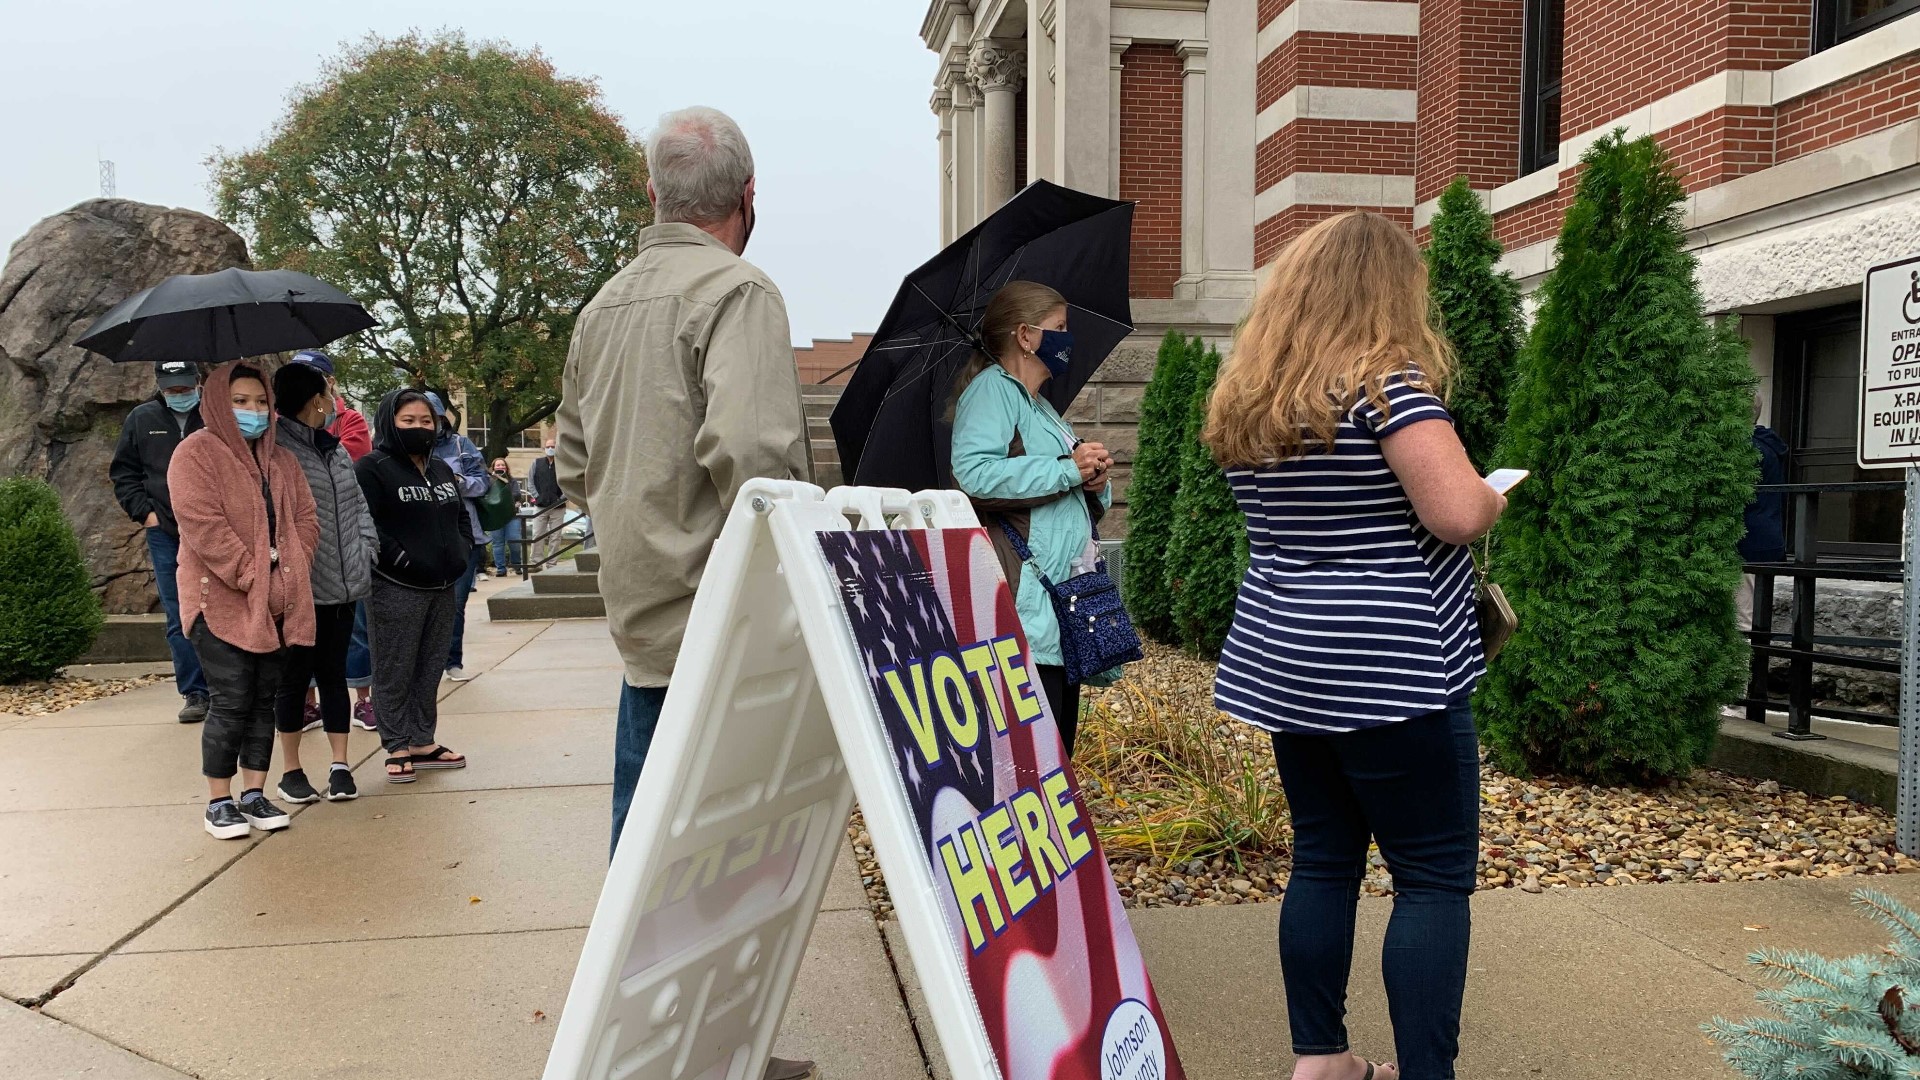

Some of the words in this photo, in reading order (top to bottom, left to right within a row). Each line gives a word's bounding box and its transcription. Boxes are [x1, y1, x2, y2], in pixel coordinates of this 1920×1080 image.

[1887, 369, 1901, 381] TO
[1904, 367, 1920, 380] PU
[1890, 428, 1905, 443] IN
[1909, 427, 1920, 443] U
[398, 482, 458, 502] GUESS
[881, 634, 1044, 769] VOTE
[938, 769, 1095, 955] HERE
[1105, 1014, 1150, 1080] Johnson
